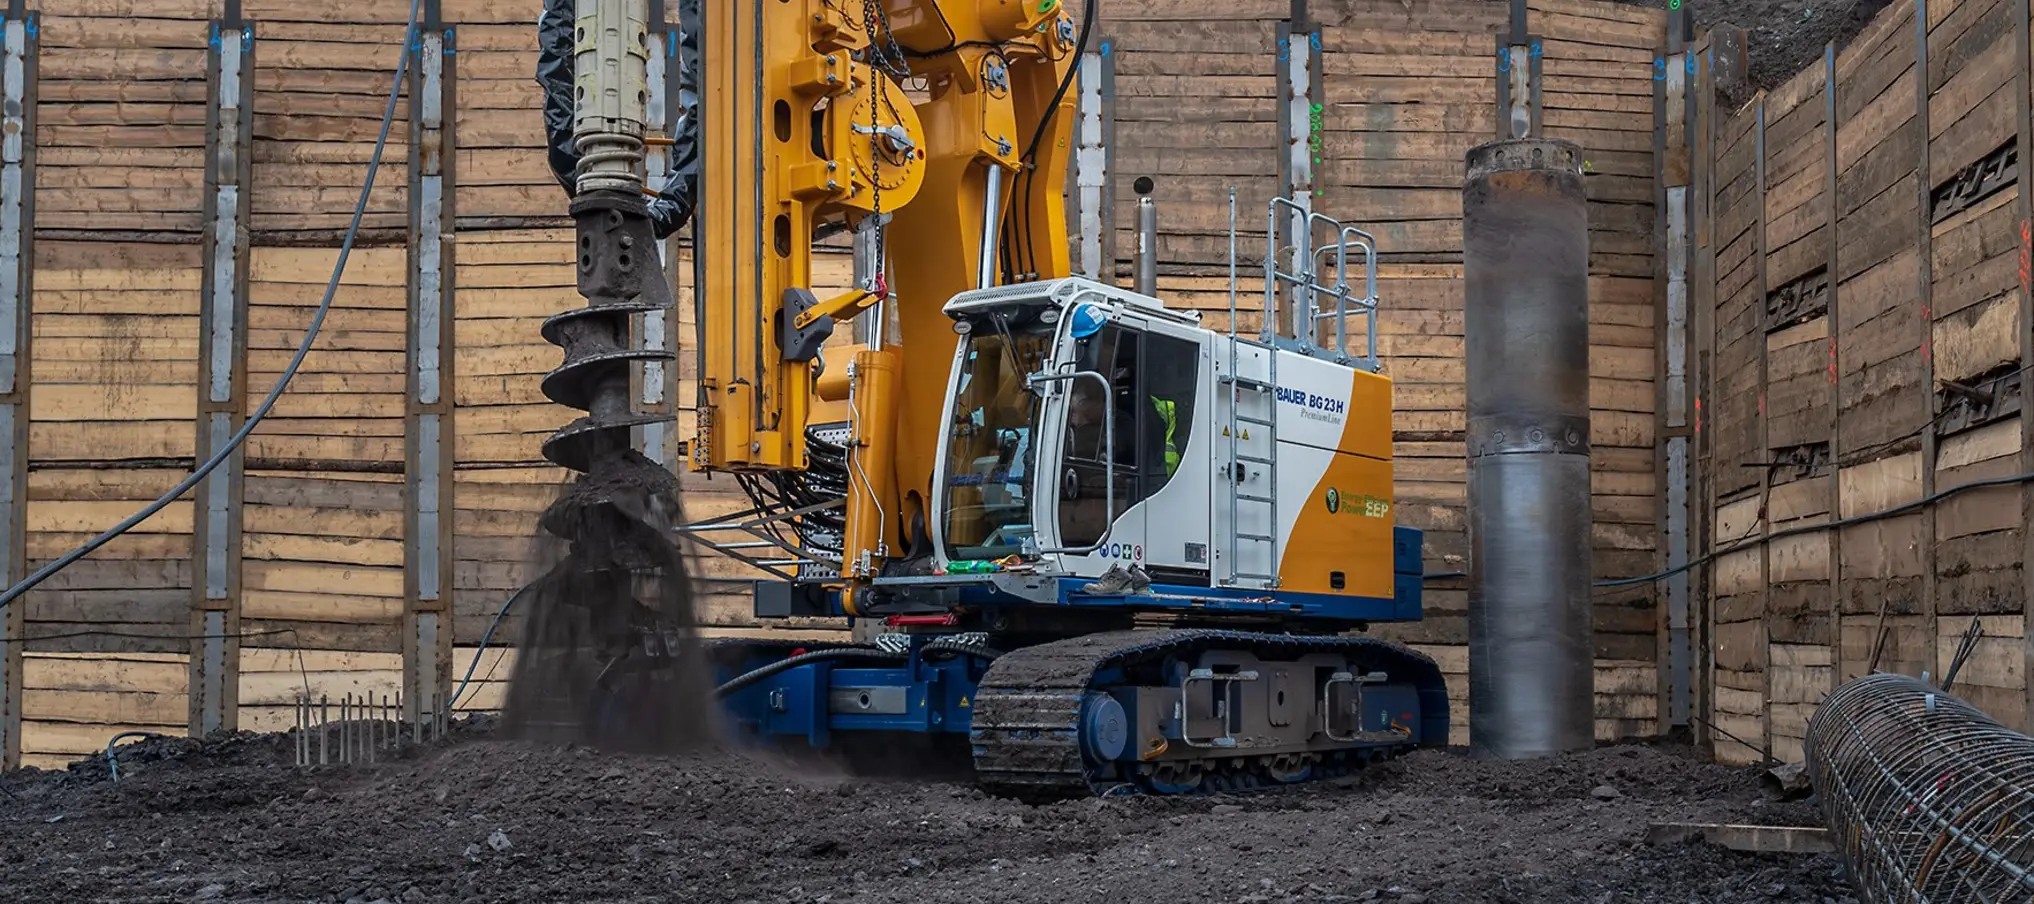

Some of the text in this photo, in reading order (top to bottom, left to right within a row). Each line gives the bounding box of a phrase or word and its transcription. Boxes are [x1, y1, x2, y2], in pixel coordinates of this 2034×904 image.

[26, 14, 39, 40] 4
[443, 29, 456, 55] 2
[1277, 31, 1322, 62] 3 8
[1497, 47, 1511, 72] 3
[1276, 386, 1307, 406] BAUER
[1365, 500, 1389, 518] EEP
